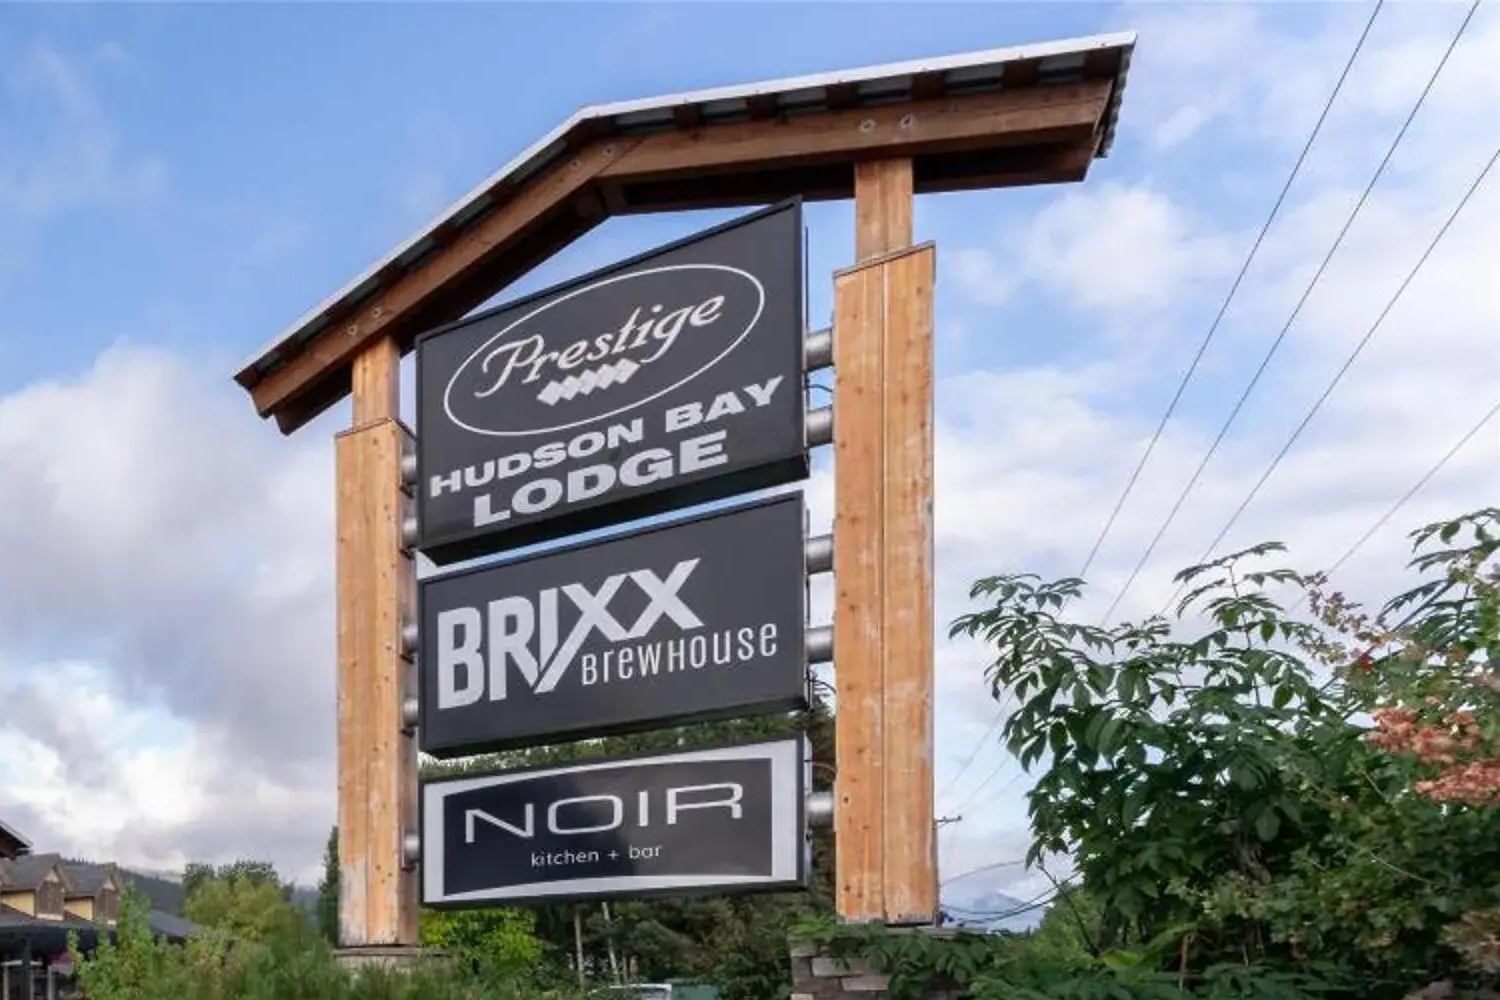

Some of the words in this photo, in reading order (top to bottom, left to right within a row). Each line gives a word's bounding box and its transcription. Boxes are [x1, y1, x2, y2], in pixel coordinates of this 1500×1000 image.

[474, 295, 725, 398] Prestige
[430, 418, 643, 497] HUDSON
[665, 375, 784, 433] BAY
[473, 430, 728, 527] LODGE
[437, 557, 704, 709] BRIXX
[465, 781, 743, 844] NOIR
[530, 849, 599, 867] kitchen
[607, 848, 619, 861] +
[628, 843, 662, 860] bar
